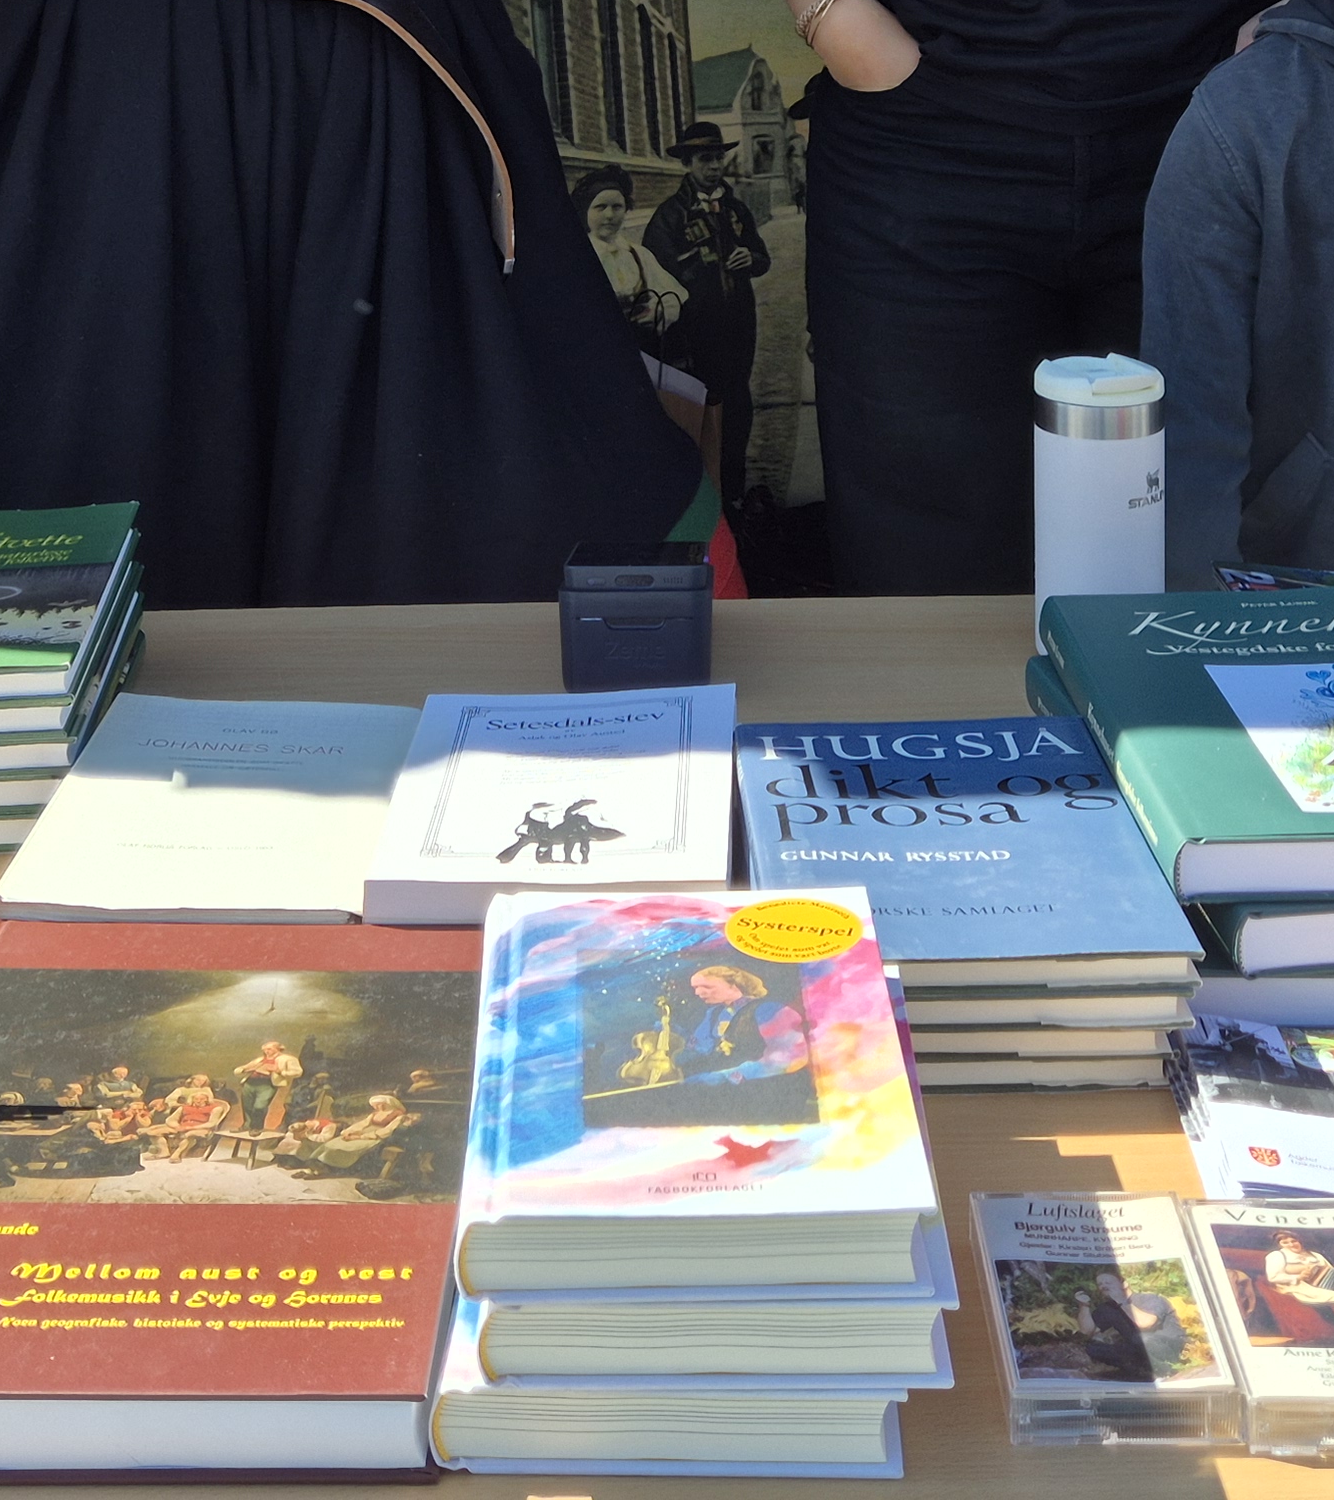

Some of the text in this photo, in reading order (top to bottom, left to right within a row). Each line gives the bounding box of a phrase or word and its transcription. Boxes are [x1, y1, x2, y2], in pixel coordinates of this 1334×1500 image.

[485, 712, 664, 731] Setesdals-stev
[138, 738, 345, 756] JOHANNES SKAR
[757, 727, 1083, 762] HUGSJÅ
[765, 764, 1119, 811] dikt og
[773, 799, 1030, 843] prosa
[780, 849, 1012, 863] GUNNAR RYSSTAD
[736, 917, 854, 937] Systerspel
[10, 1262, 414, 1285] Mellom aust og vest
[170, 1290, 180, 1304] i
[248, 1293, 276, 1308] og
[205, 1320, 224, 1330] og
